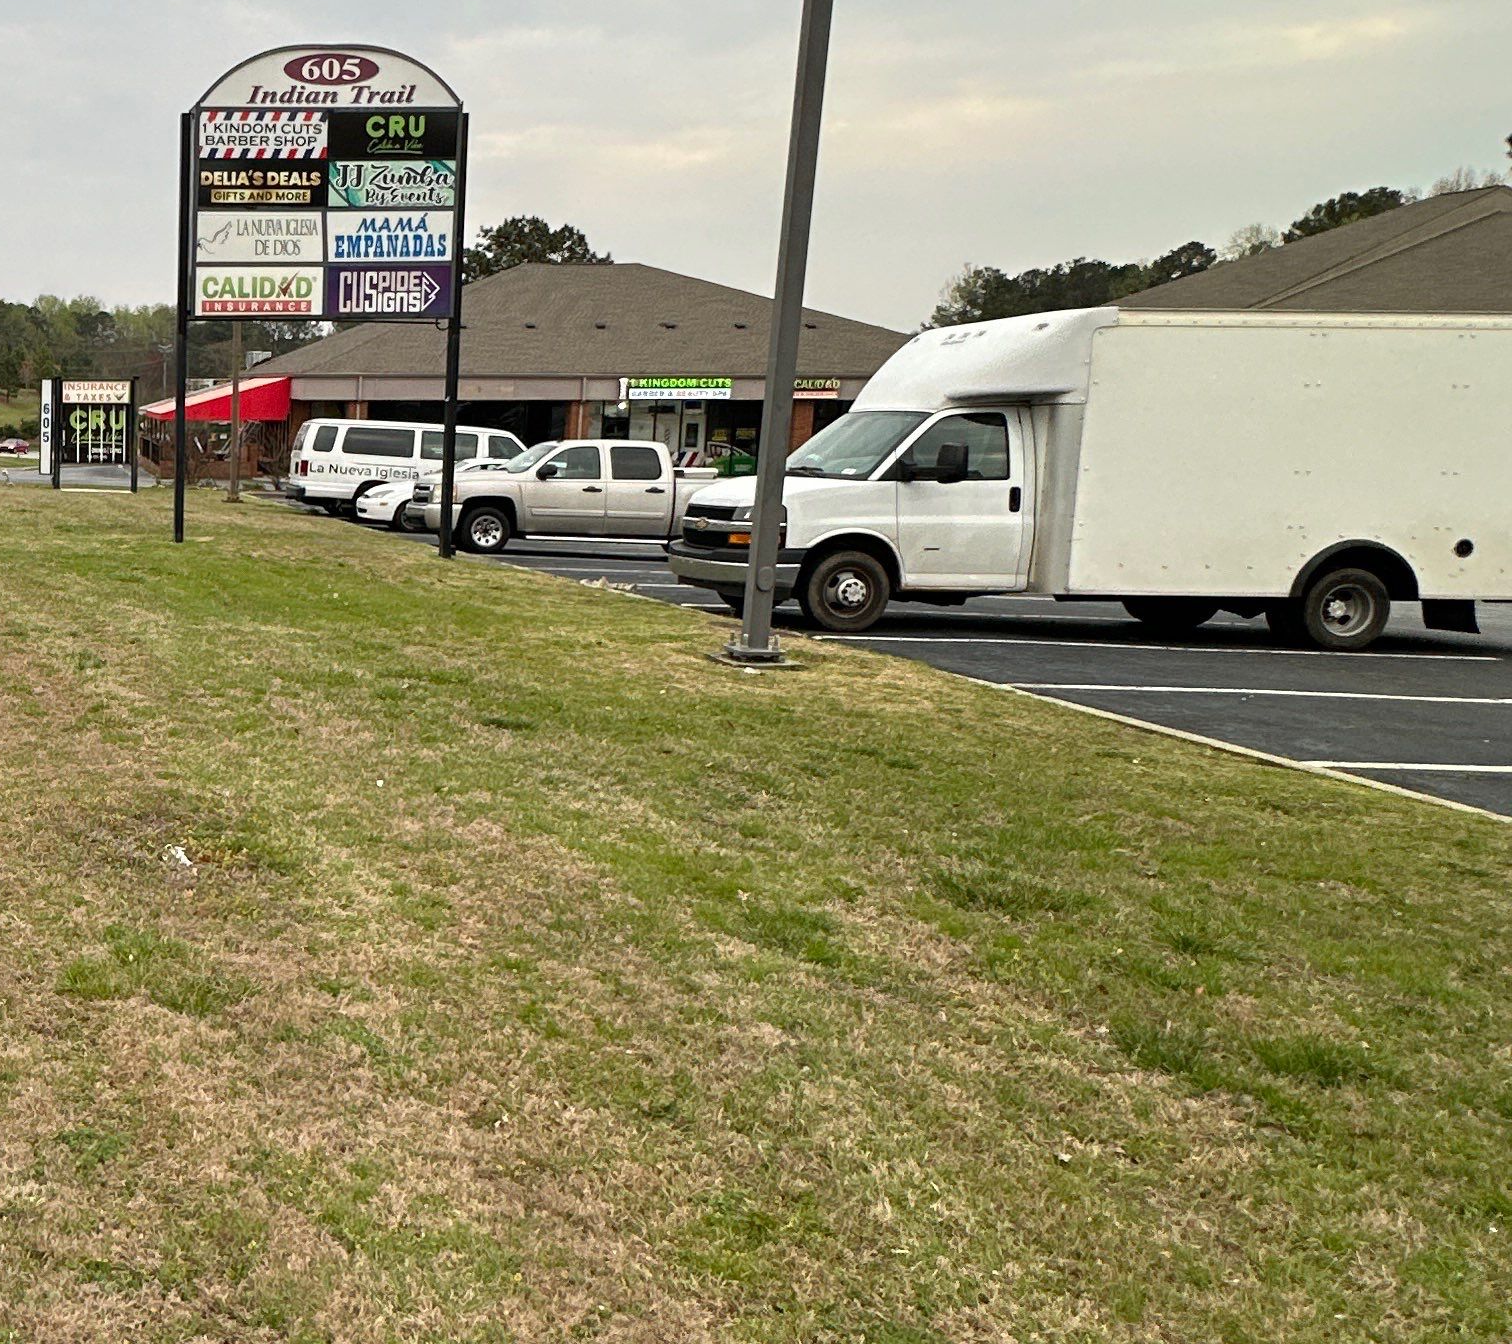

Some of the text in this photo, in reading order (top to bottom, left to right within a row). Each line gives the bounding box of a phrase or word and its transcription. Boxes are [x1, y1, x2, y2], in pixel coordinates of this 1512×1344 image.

[300, 57, 362, 81] 605
[246, 84, 417, 105] Indian Trail
[202, 123, 323, 135] 1 KINDOM CUTS
[365, 115, 426, 138] CRU
[205, 135, 318, 147] BARBER SHOP
[200, 169, 322, 186] DELIA'S DEALS
[335, 164, 450, 190] JJ Zumba
[213, 191, 308, 201] GIFTS AND MORE
[364, 187, 446, 205] By Events
[236, 219, 319, 236] LA NUEVA IGLESIA
[356, 212, 429, 233] MAMÁ
[254, 239, 302, 256] DE DIOS
[334, 233, 447, 258] EMPANADAS
[202, 271, 313, 299] CALIDAD
[205, 301, 309, 311] INSURANCE
[64, 383, 127, 391] INSURANCE
[699, 378, 732, 388] CUTS
[76, 393, 112, 401] TAXES
[69, 409, 126, 430] CRU
[309, 462, 325, 474] La
[329, 463, 371, 476] Nueva
[376, 467, 420, 480] Iglesia
